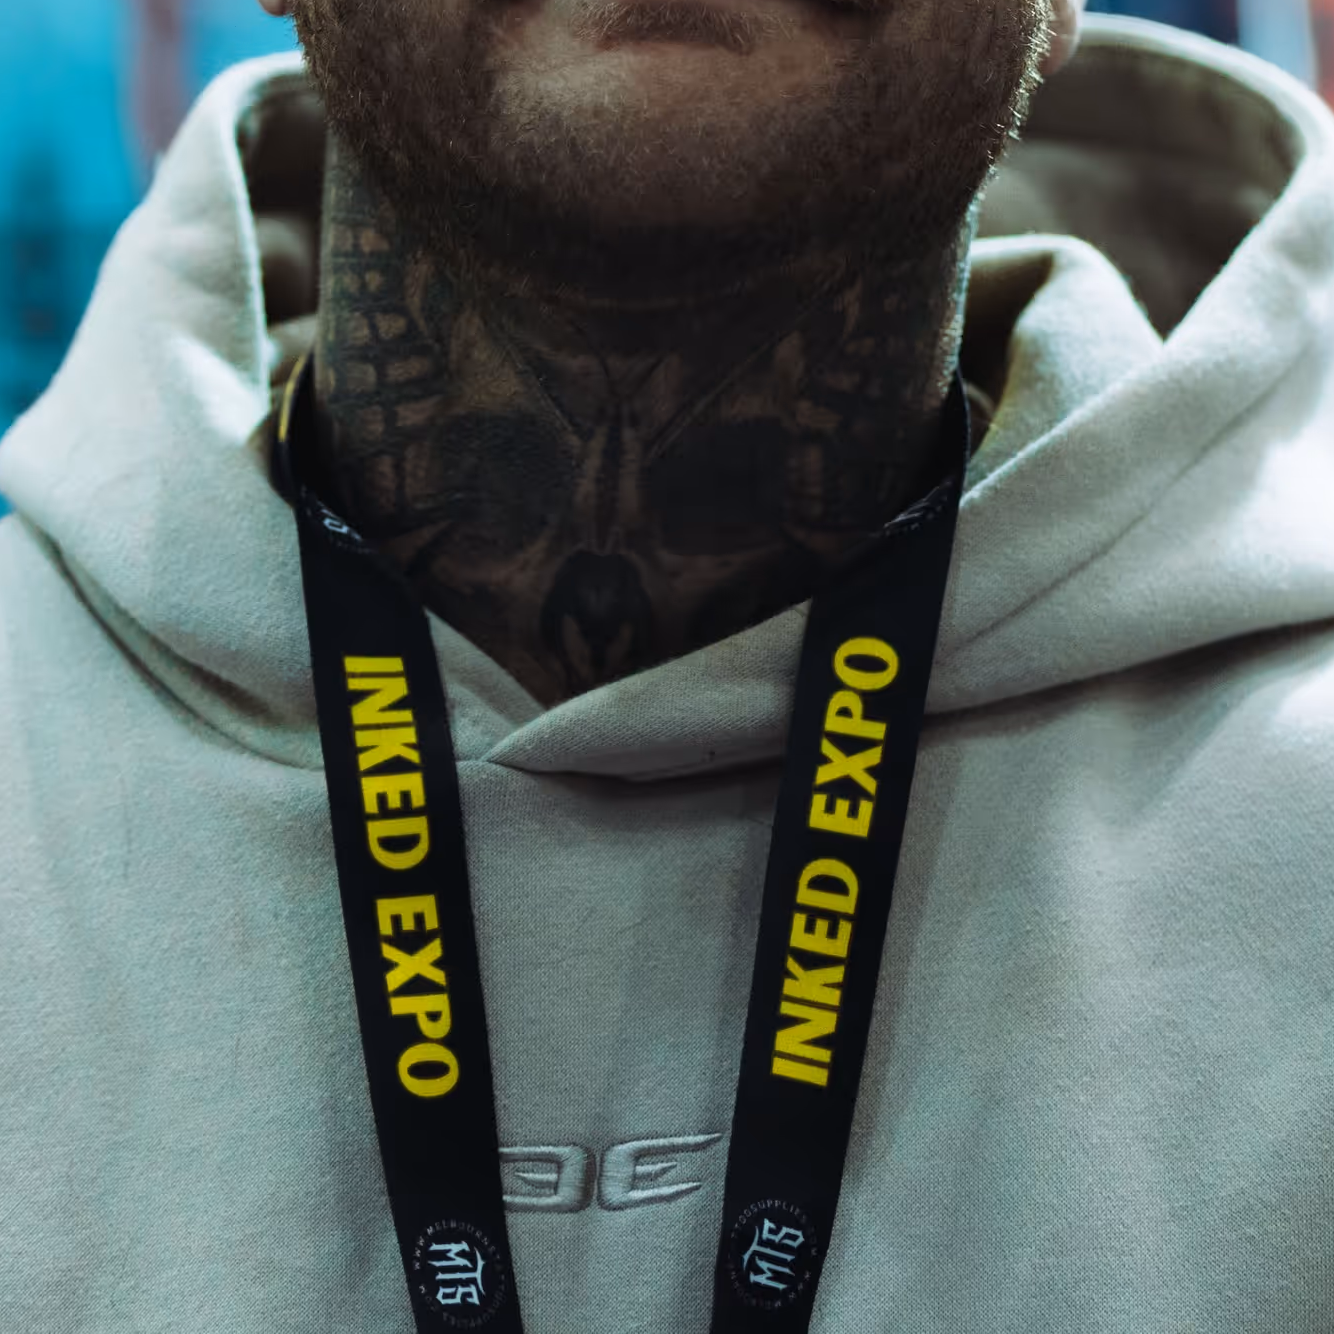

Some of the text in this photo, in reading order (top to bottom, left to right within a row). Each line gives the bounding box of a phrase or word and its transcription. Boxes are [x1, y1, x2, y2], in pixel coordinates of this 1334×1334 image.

[343, 655, 430, 870] INKED
[808, 636, 900, 838] EXPO
[376, 894, 460, 1098] EXPO
[771, 857, 860, 1087] INKED
